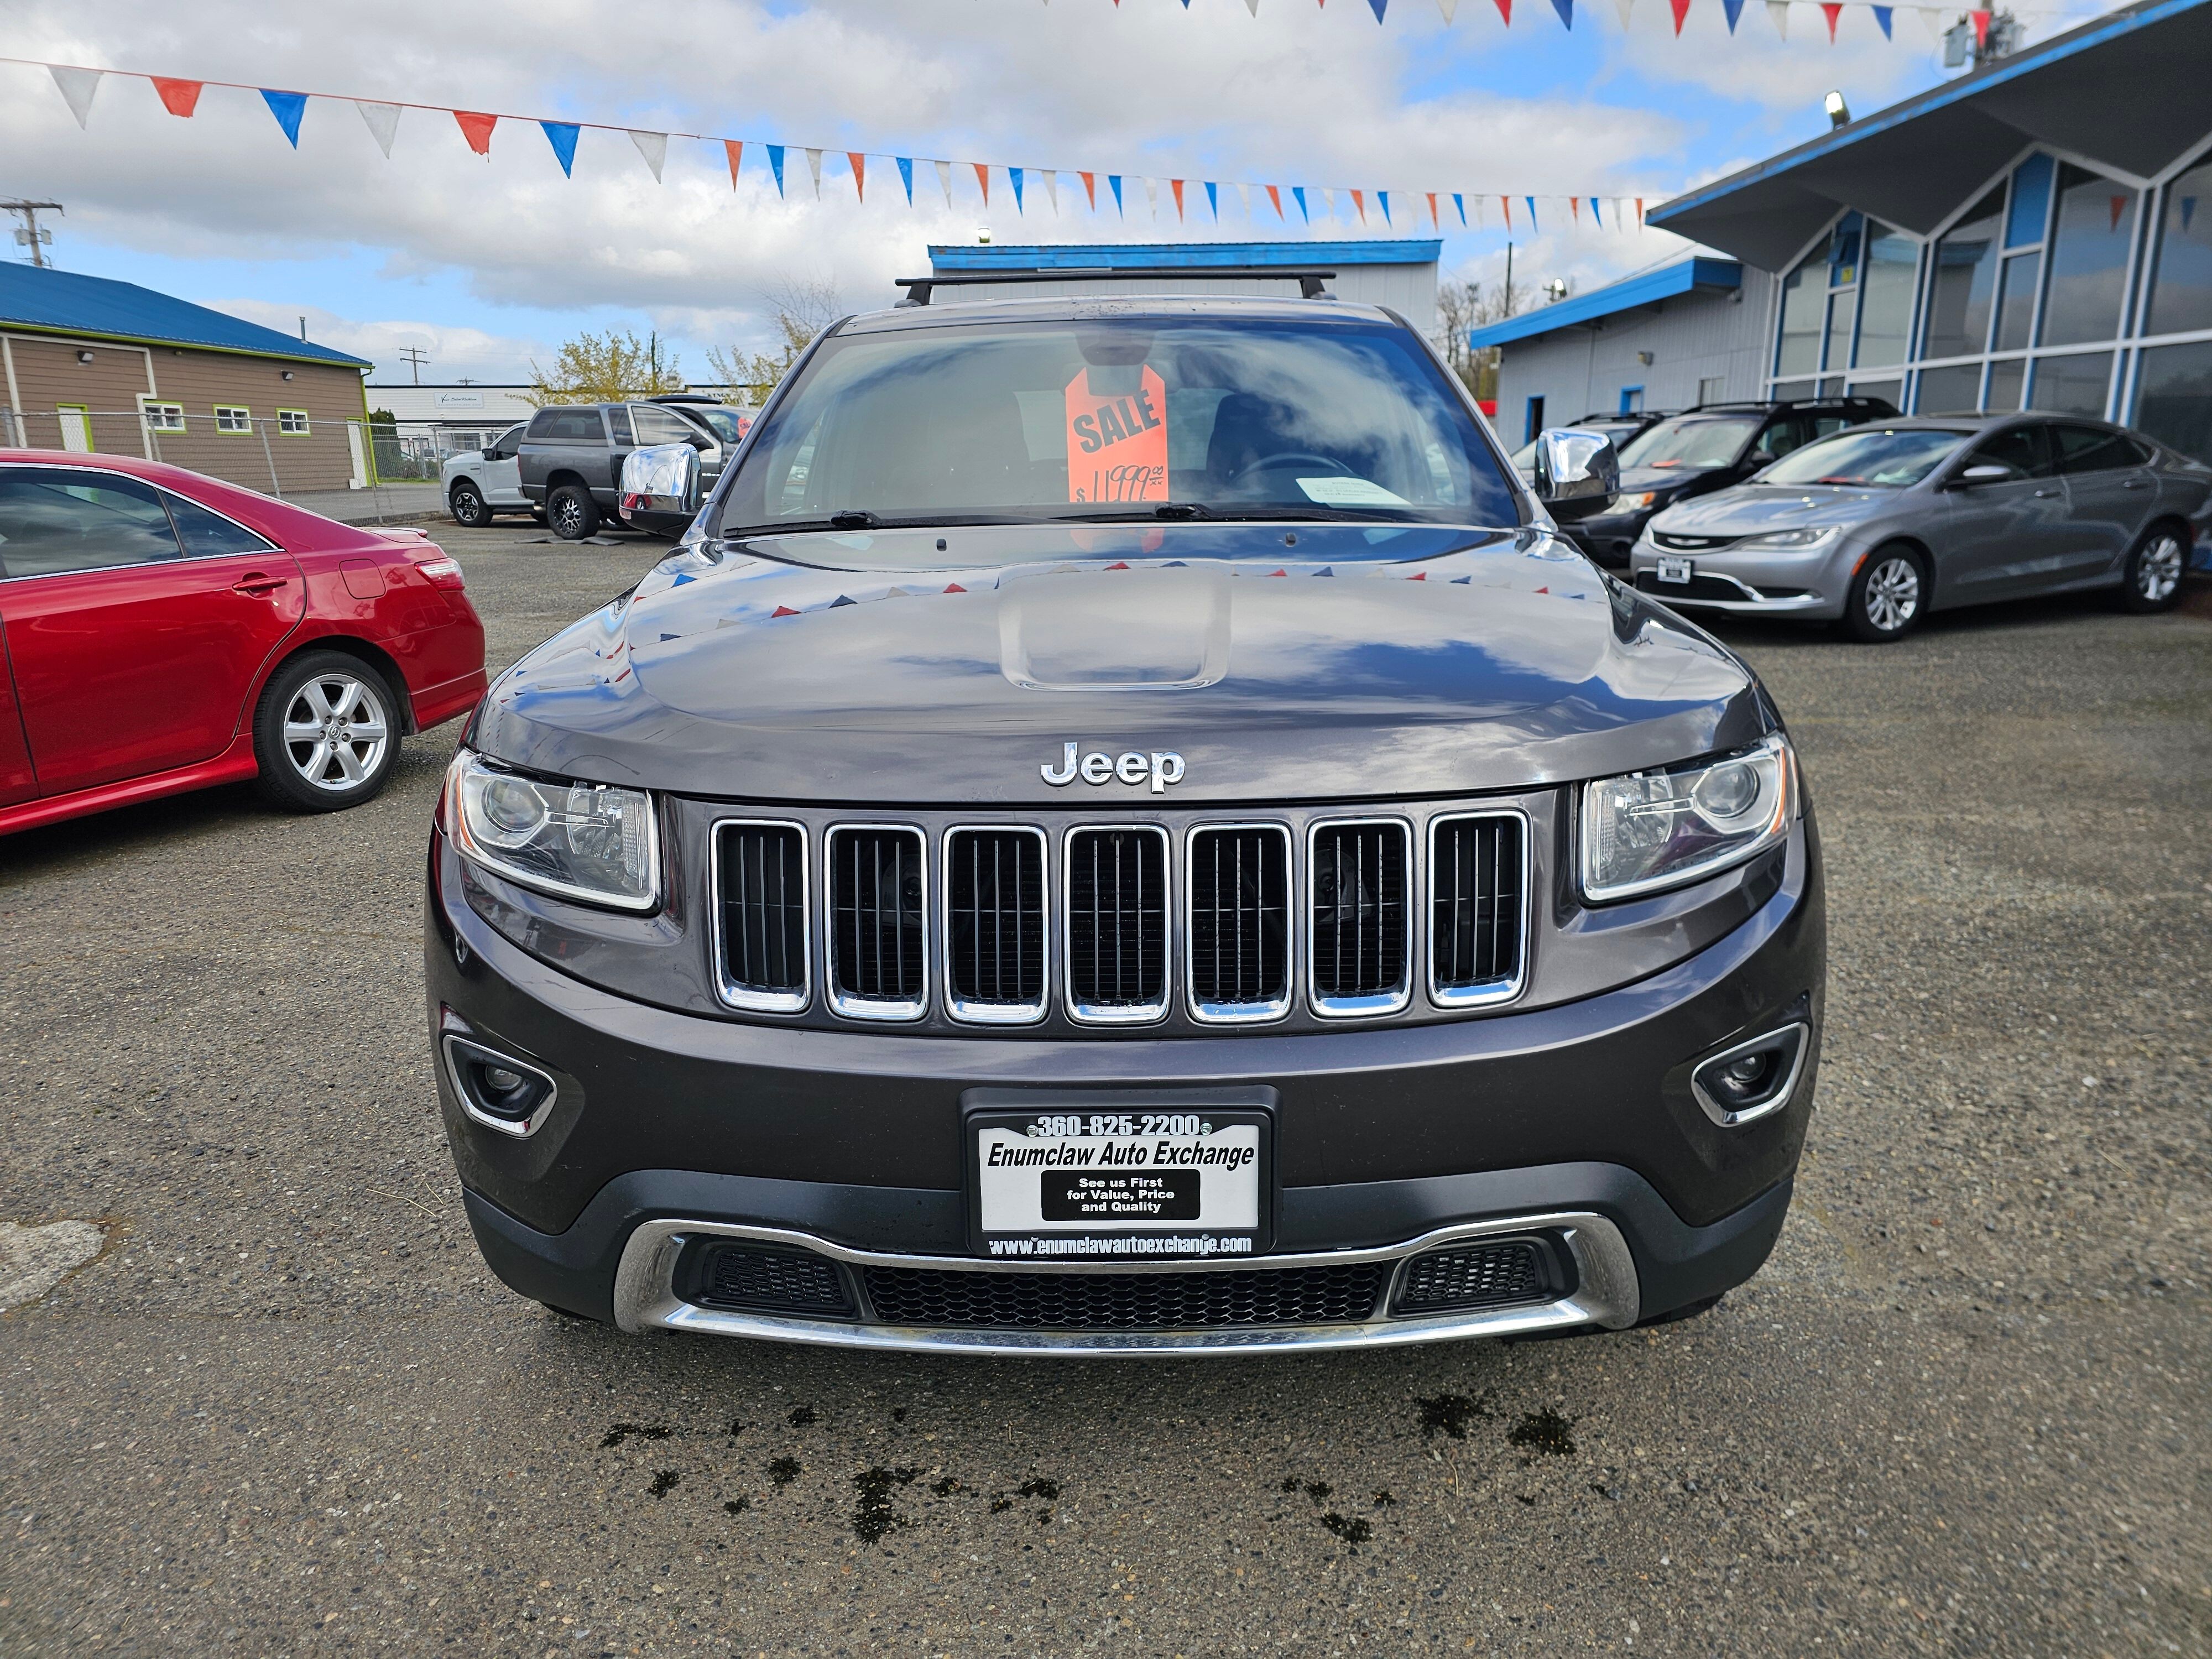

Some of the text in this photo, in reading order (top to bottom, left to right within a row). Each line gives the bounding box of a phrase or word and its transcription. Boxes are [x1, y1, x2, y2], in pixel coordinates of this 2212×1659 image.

[1073, 389, 1161, 453] SALE
[1040, 742, 1186, 794] Jeep
[1037, 1115, 1199, 1137] 360-825-2200
[987, 1141, 1254, 1171] Enumclaw Auto Exchange
[1079, 1178, 1105, 1188] See
[1130, 1177, 1163, 1187] First
[1067, 1189, 1175, 1201] for Value, Price
[1081, 1201, 1161, 1213] and Quality
[988, 1235, 1252, 1255] www.enumclawautoexchange.com
